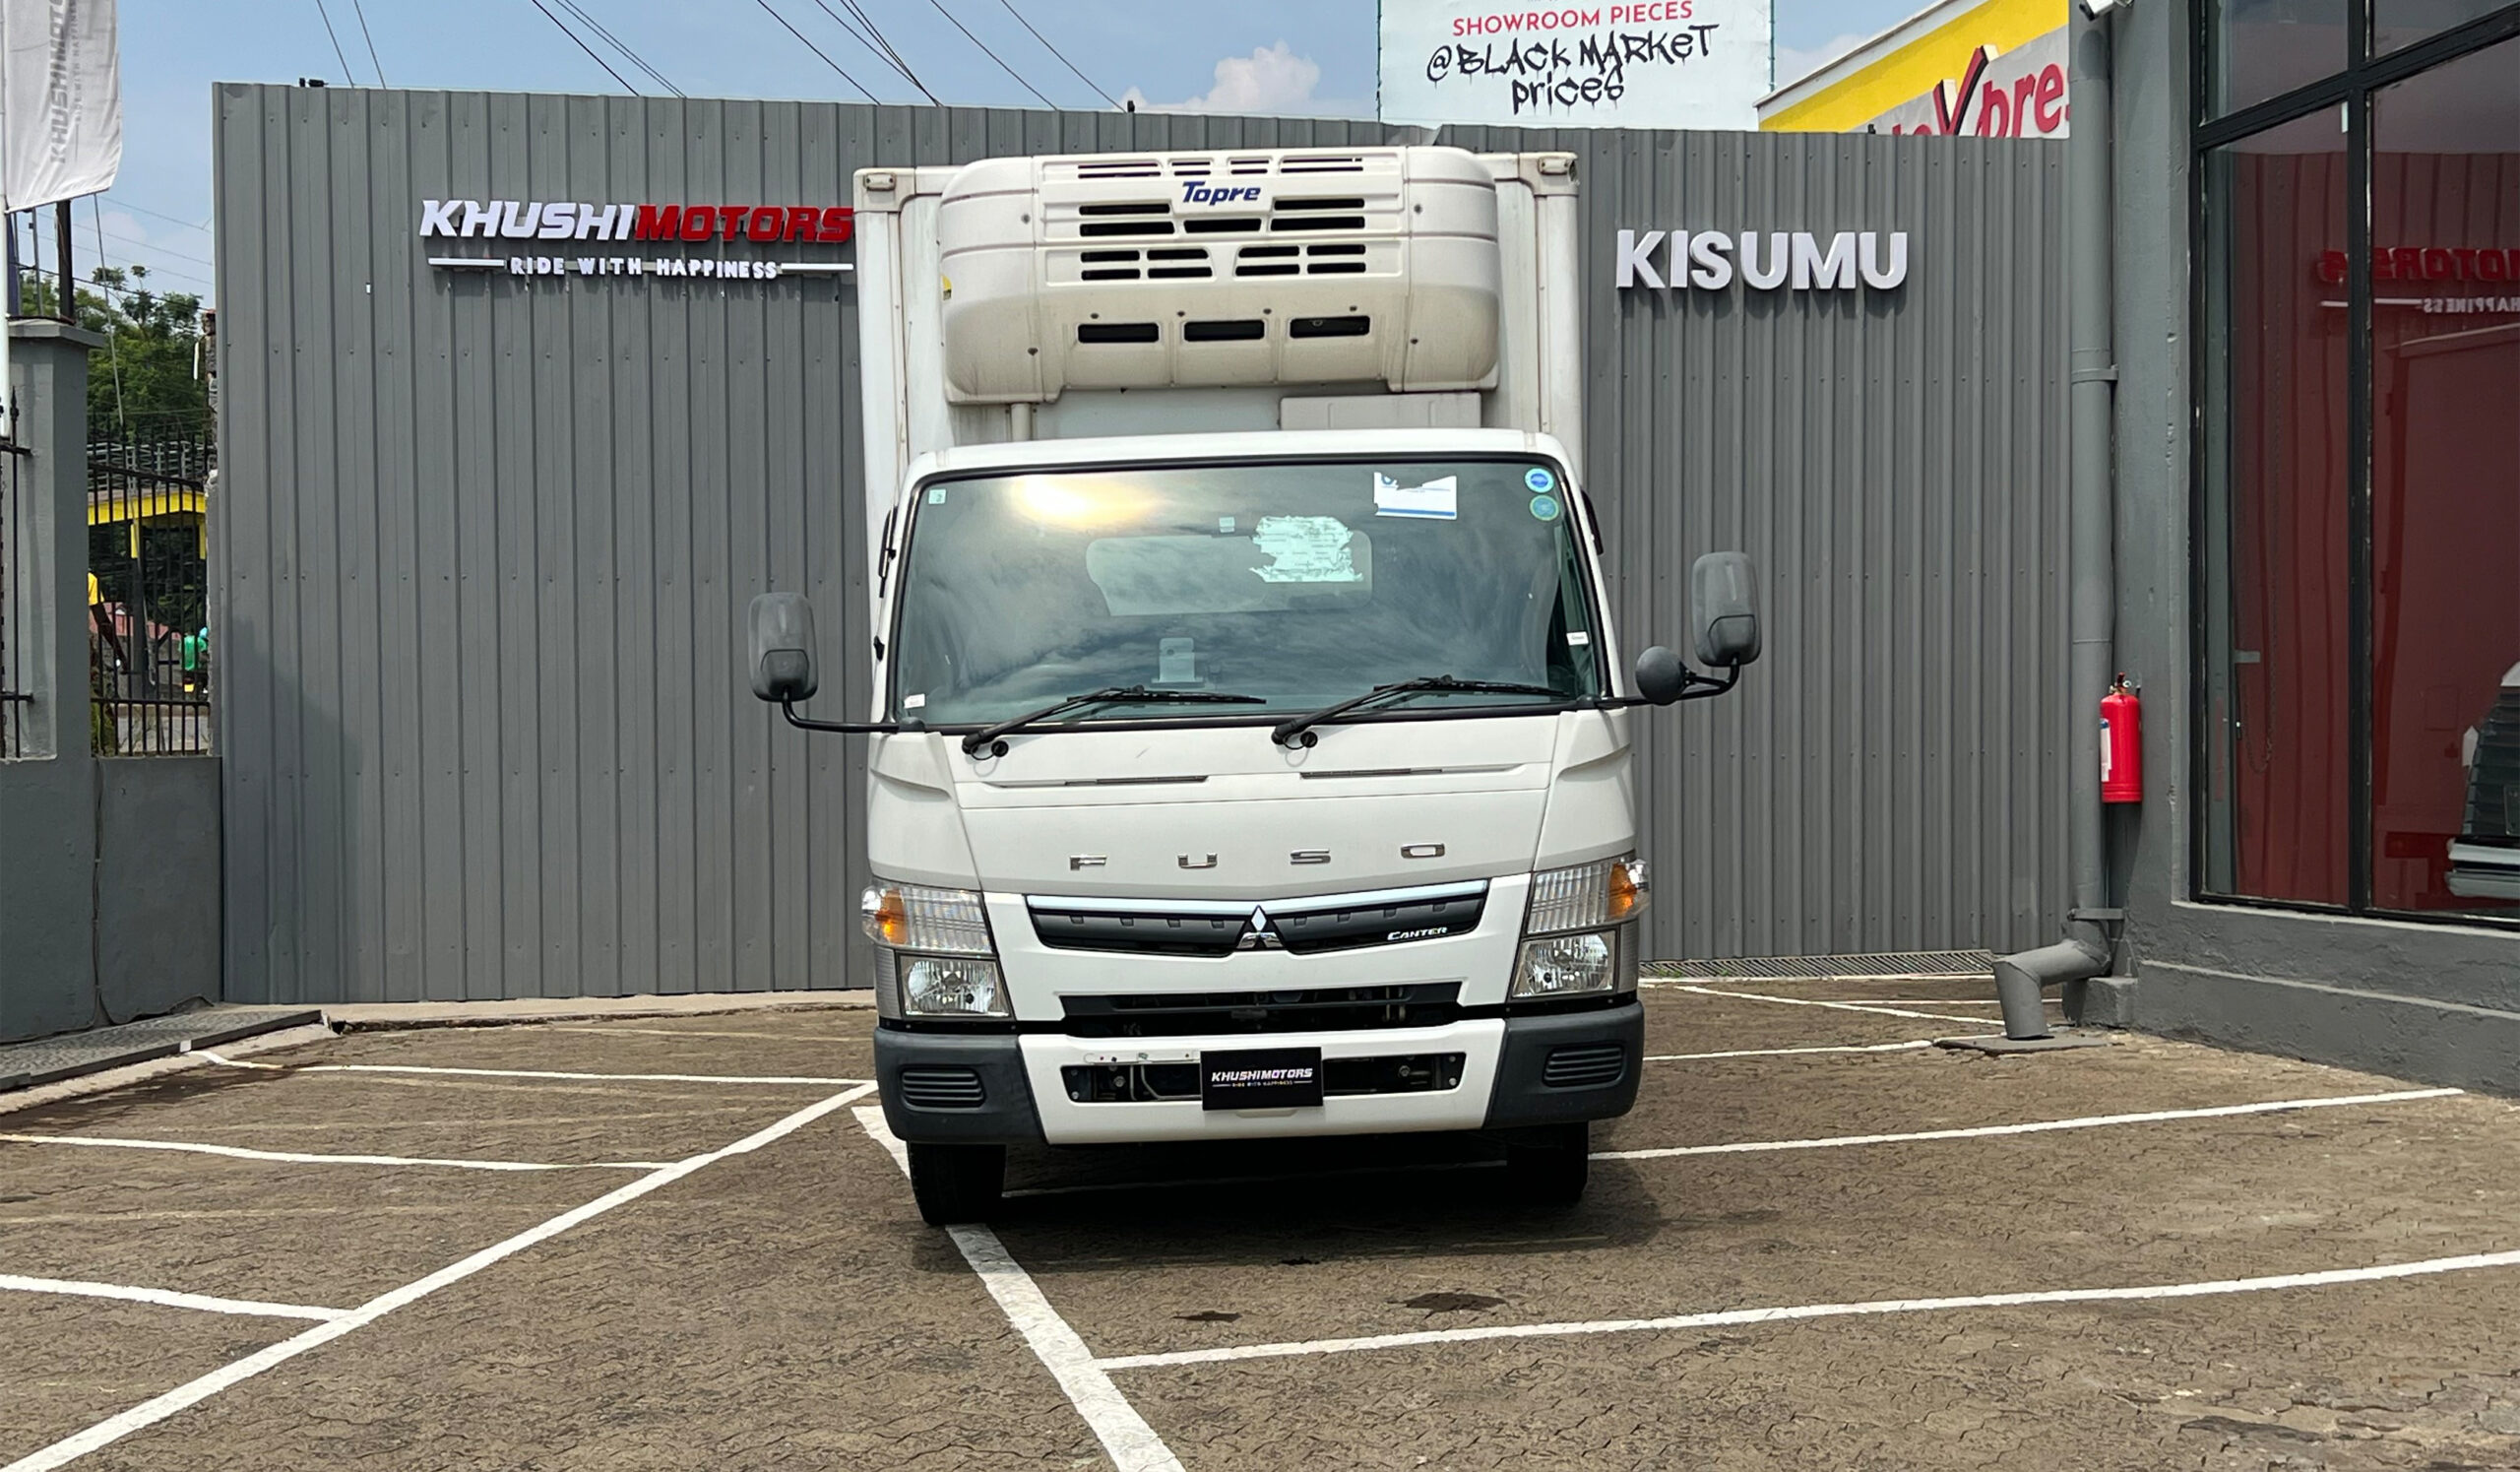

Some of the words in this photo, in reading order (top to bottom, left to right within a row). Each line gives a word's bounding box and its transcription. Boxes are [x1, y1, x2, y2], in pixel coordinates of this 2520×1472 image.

[1453, 9, 1601, 36] SHOWROOM
[1609, 0, 1693, 24] PIECES
[1512, 65, 1624, 115] prices
[1182, 180, 1261, 206] Topre
[510, 257, 564, 275] RIDE
[578, 257, 642, 276] WITH
[657, 258, 778, 280] HAPPINESS
[1616, 229, 1908, 289] KISUMU
[1070, 843, 1445, 870] FUSO
[1211, 1067, 1313, 1082] KHUSHIMOTORS
